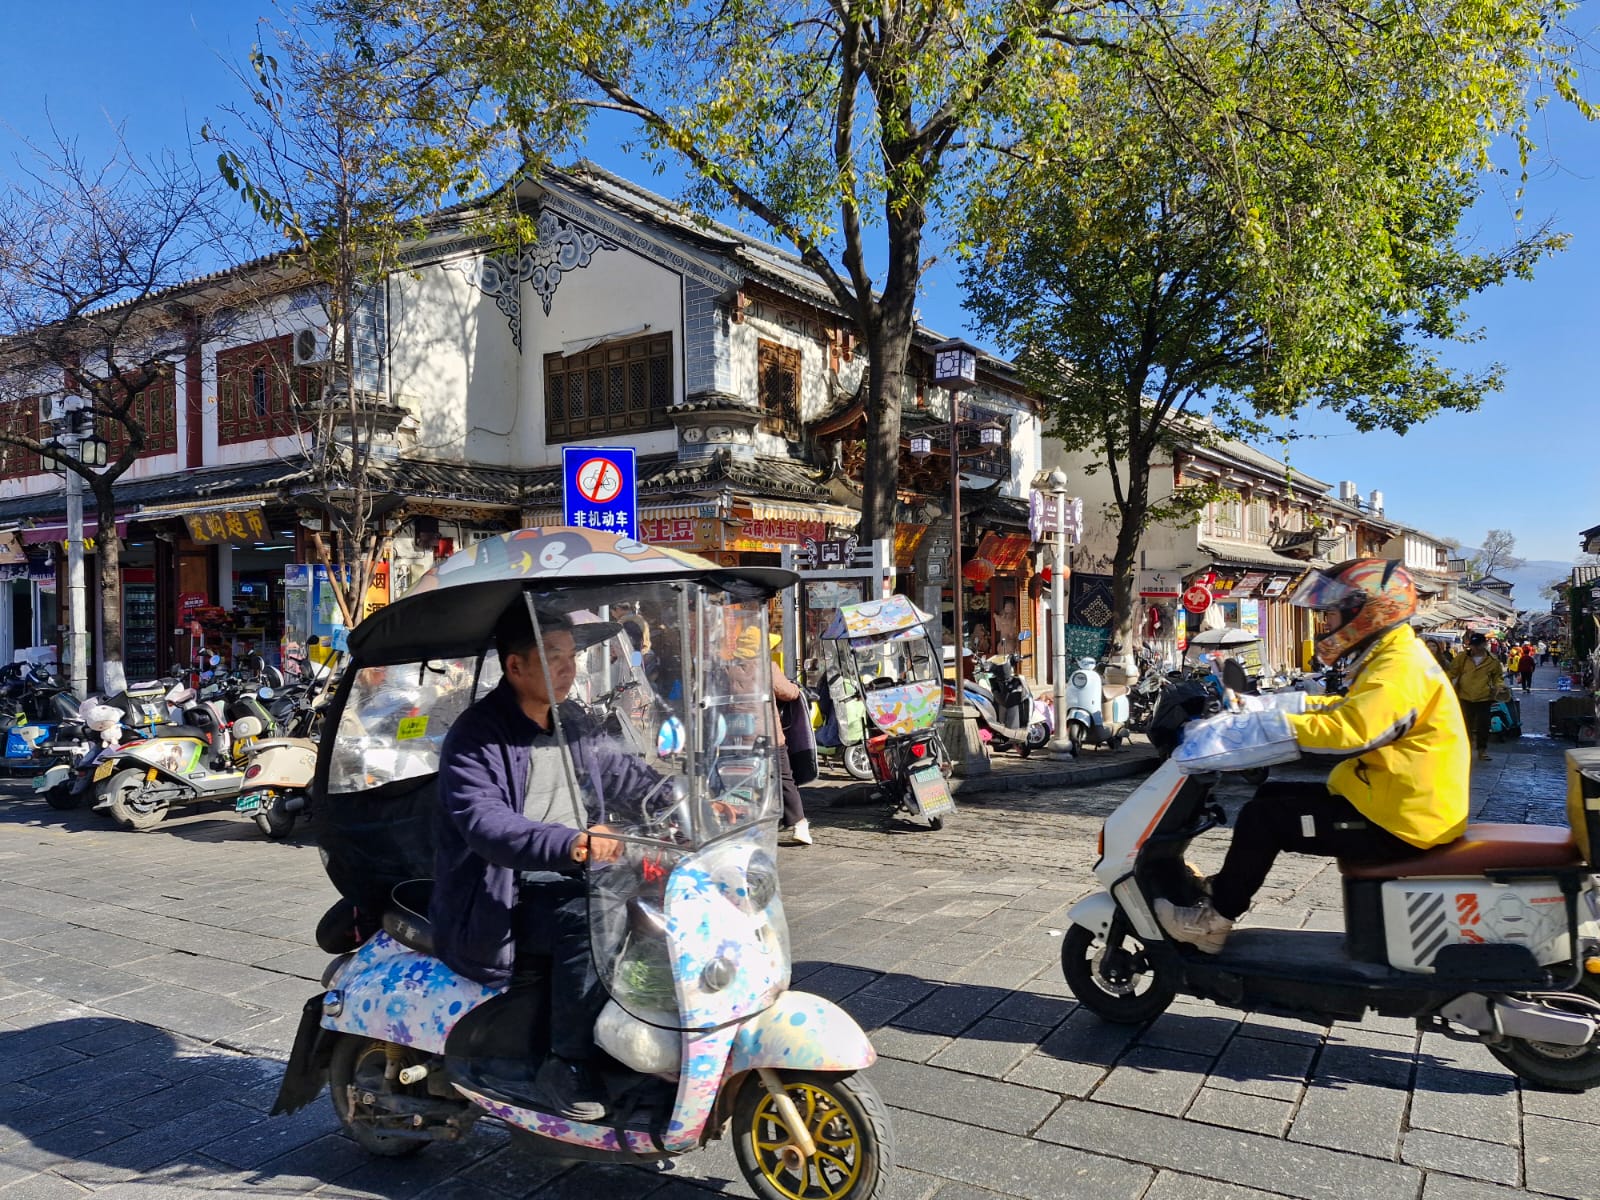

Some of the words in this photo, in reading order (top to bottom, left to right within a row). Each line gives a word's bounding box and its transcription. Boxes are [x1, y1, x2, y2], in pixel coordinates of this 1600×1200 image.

[573, 510, 628, 527] 非机动车
[742, 517, 797, 539] 云南小土豆
